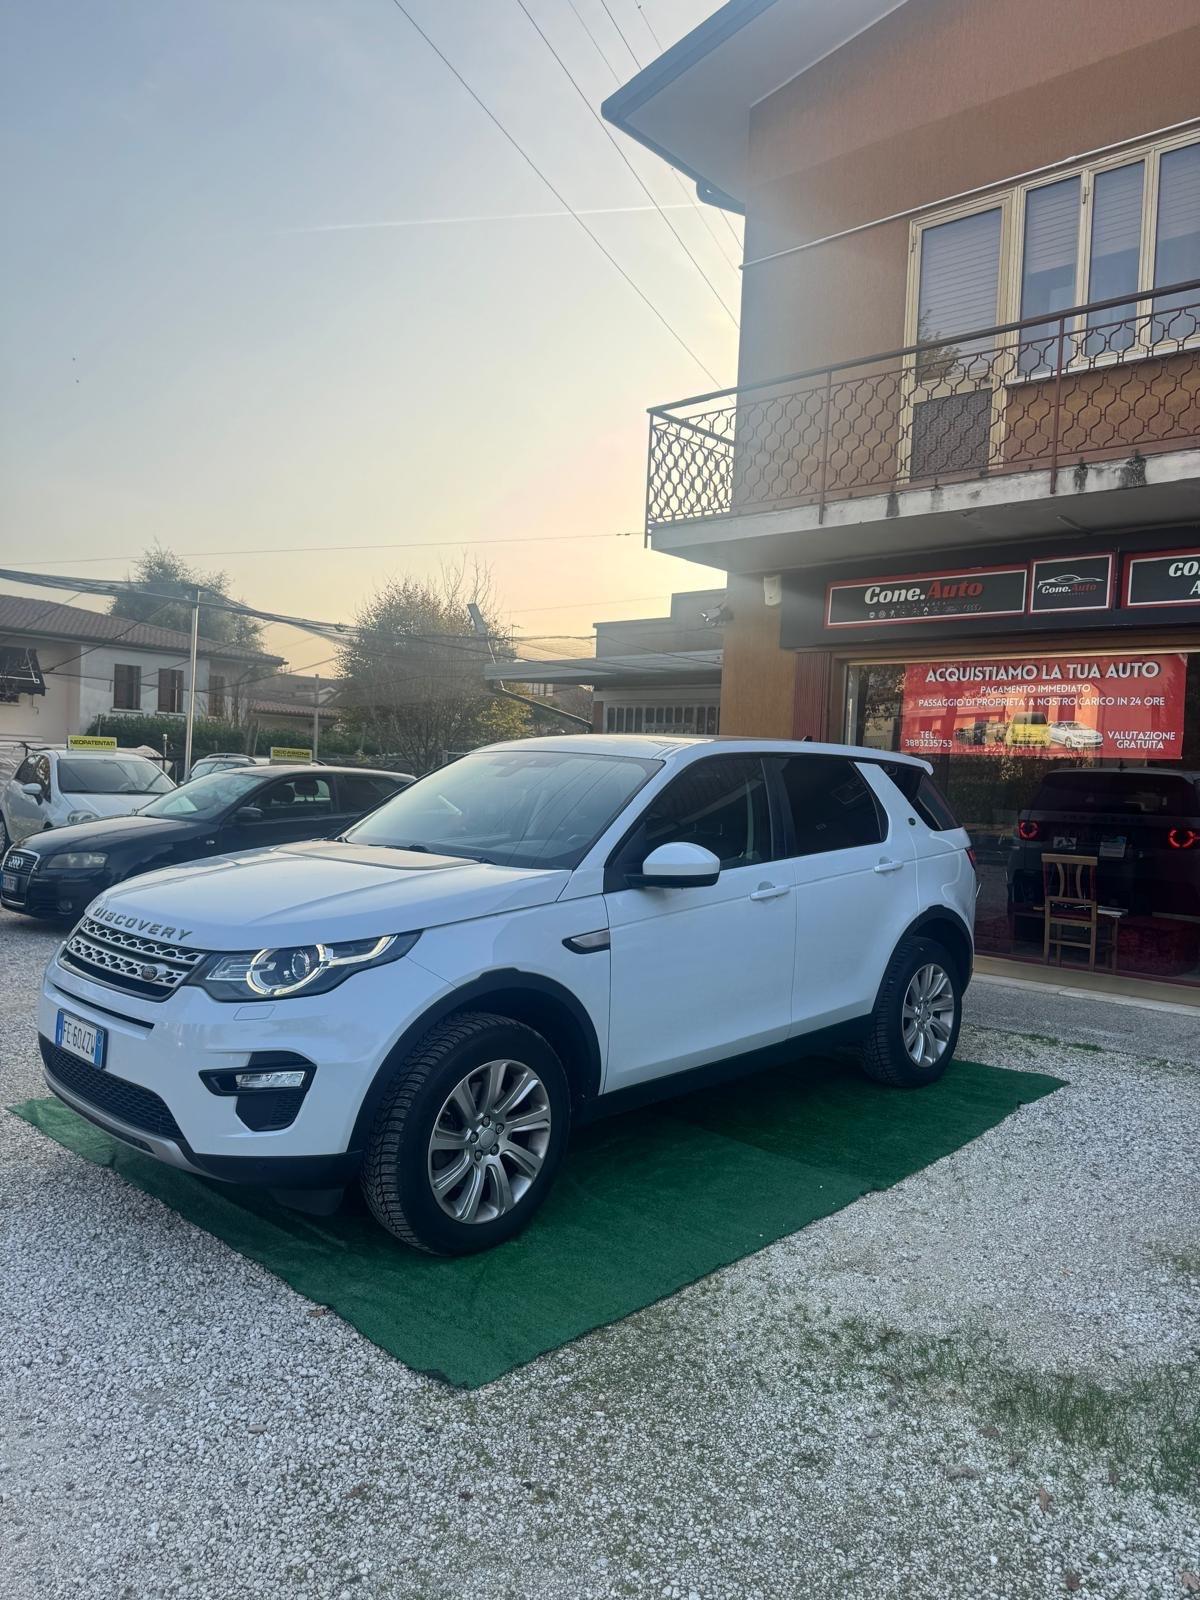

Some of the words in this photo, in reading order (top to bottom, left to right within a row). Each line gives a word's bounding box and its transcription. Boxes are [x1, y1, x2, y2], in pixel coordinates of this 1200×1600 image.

[1168, 561, 1200, 577] CO
[864, 581, 984, 604] Cone.Auto
[925, 665, 1038, 683] ACQUISTIAMO
[1042, 664, 1062, 680] LA
[1066, 663, 1101, 679] TUA
[1105, 662, 1160, 678] AUTO
[980, 685, 1036, 694] PAGAMENTO
[1037, 684, 1091, 693] IMMEDIATO
[918, 698, 964, 707] PASSAGGIO
[965, 698, 975, 707] DI
[1028, 698, 1035, 706] A
[1037, 697, 1077, 706] NOSTRO
[1078, 697, 1115, 706] CARICO
[1117, 697, 1127, 705] IN
[1130, 697, 1141, 705] 24
[1143, 697, 1165, 706] ORE
[920, 730, 937, 739] TEL.
[1107, 731, 1176, 740] VALUTAZIONE
[905, 738, 953, 747] 3883235753
[1116, 740, 1164, 749] GRATUITA
[93, 907, 193, 941] DISCOVERY
